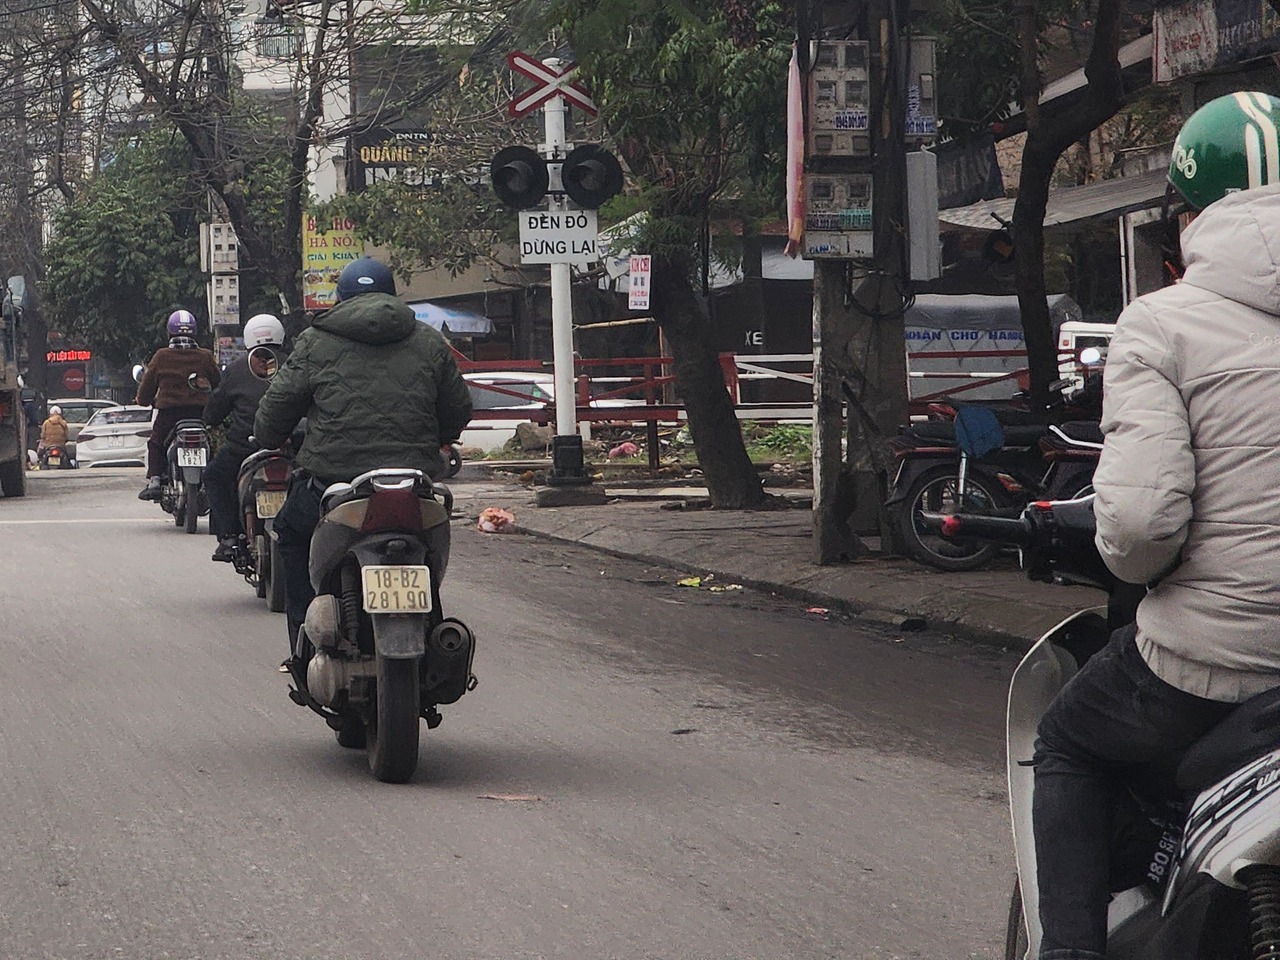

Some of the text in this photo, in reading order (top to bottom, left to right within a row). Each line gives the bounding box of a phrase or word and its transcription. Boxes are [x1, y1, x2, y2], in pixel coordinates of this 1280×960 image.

[360, 140, 413, 163] QUẢNG
[365, 167, 397, 186] IN
[528, 210, 588, 230] ĐÈN ĐỎ
[523, 239, 596, 256] DỪNG LẠI
[745, 331, 763, 346] XE
[374, 570, 420, 588] 18-B2
[369, 590, 428, 609] 281.90
